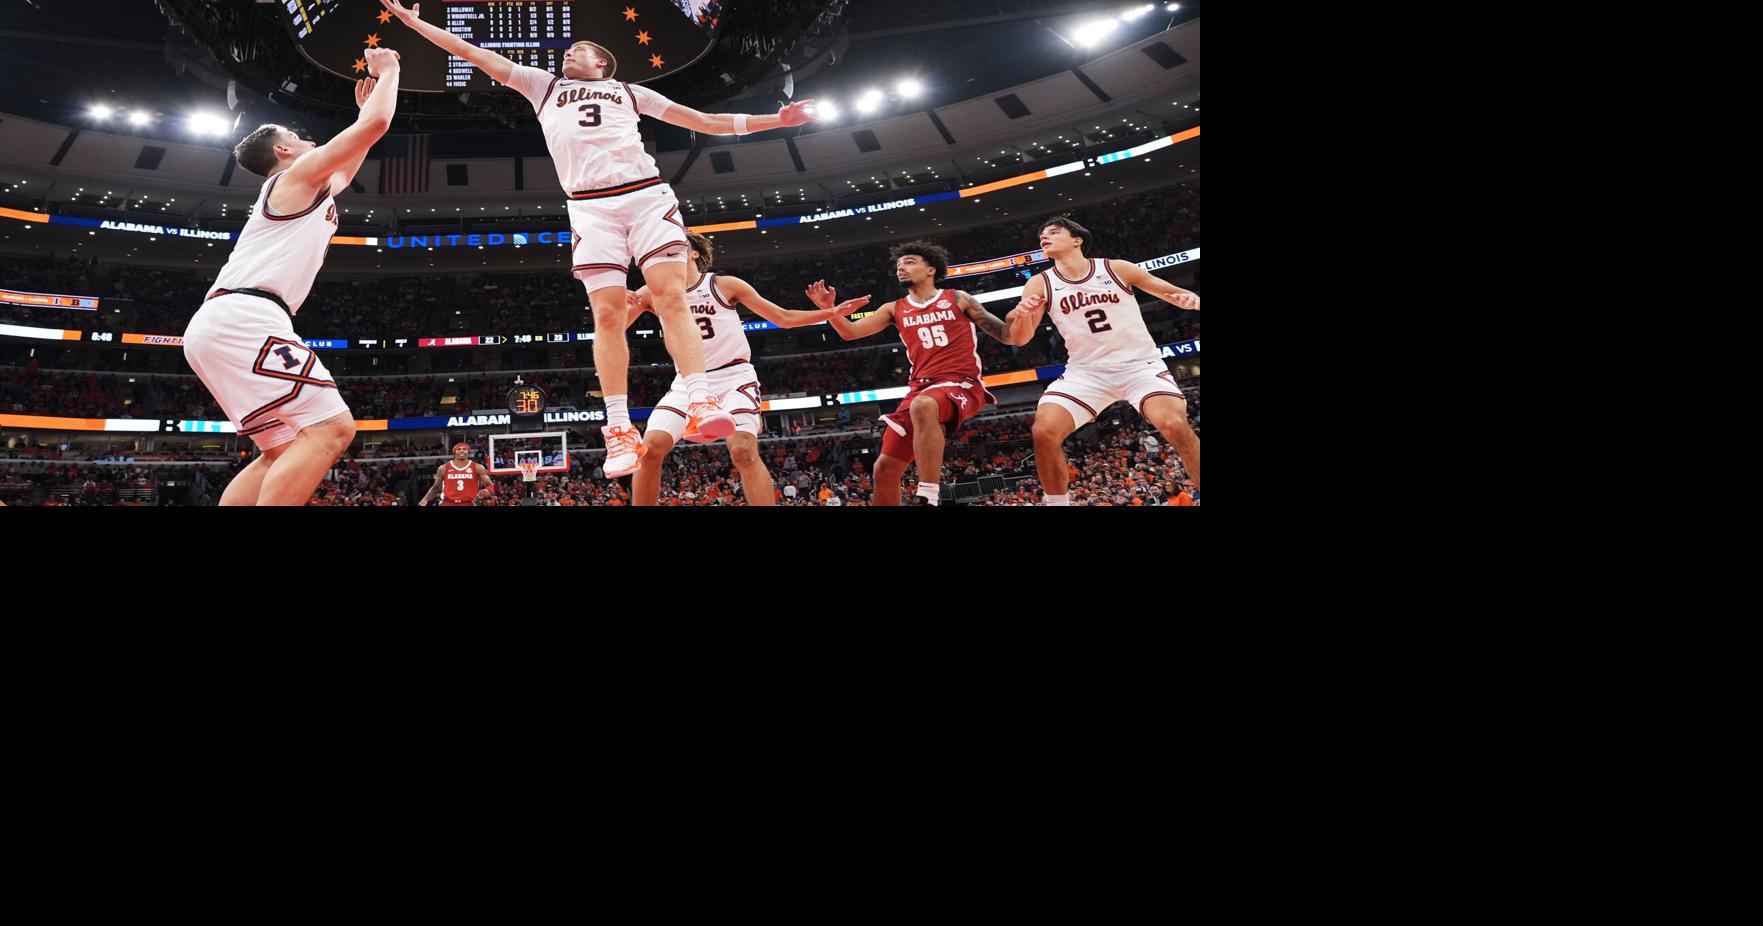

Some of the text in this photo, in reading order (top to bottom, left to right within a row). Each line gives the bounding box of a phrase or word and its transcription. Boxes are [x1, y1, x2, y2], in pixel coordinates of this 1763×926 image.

[556, 87, 623, 108] Illinois
[578, 103, 601, 127] 3
[800, 208, 855, 223] ALABAMA
[868, 198, 915, 213] ILLINOIS
[100, 220, 164, 235] ALABAMA
[180, 228, 231, 241] ILLINOIS
[387, 232, 571, 248] UNITED CE
[1138, 252, 1189, 270] LINOIS
[689, 301, 716, 315] nois
[1060, 290, 1120, 315] Illinois
[695, 316, 715, 340] 3
[742, 322, 768, 330] CLUB
[902, 310, 956, 328] ALABAMA
[1084, 308, 1112, 334] 2
[143, 336, 184, 344] FIGHTI
[444, 337, 472, 345] ALABAMA
[577, 333, 596, 341] ILLIN
[917, 324, 949, 349] 95
[273, 345, 301, 370] I
[519, 391, 539, 400] 7:46
[516, 399, 538, 414] 30
[447, 411, 605, 427] ALABAM ILLINOIS
[456, 480, 464, 491] 3
